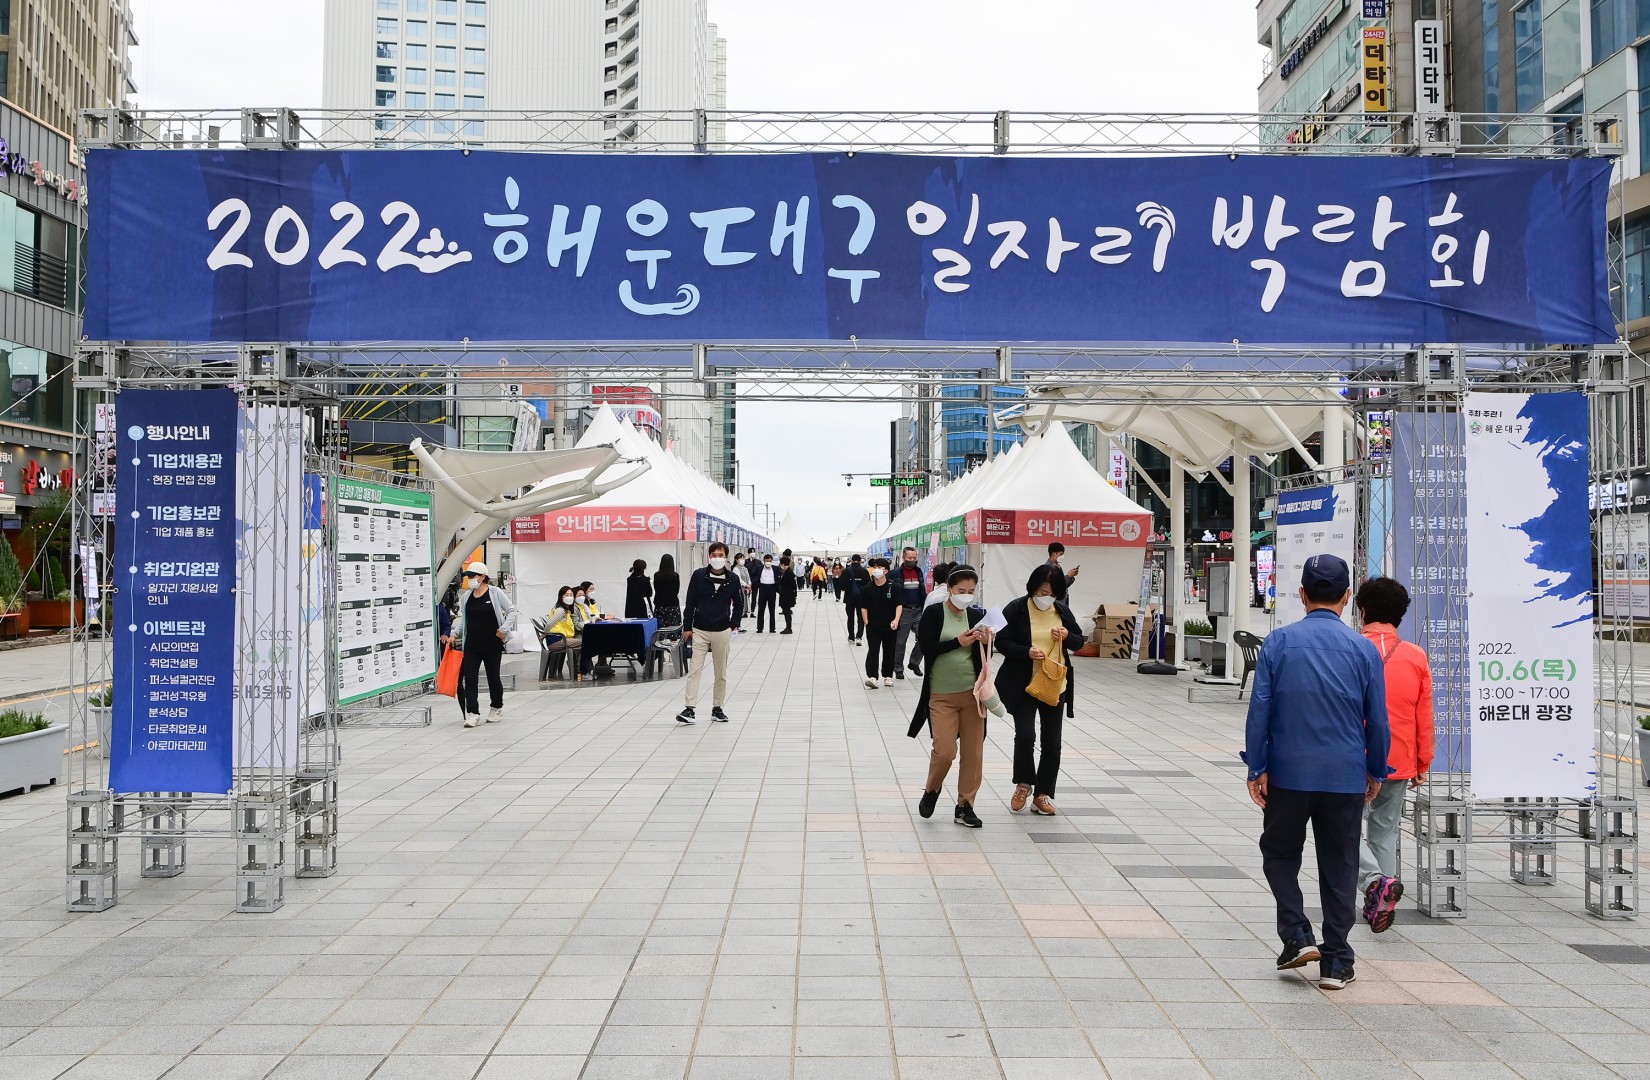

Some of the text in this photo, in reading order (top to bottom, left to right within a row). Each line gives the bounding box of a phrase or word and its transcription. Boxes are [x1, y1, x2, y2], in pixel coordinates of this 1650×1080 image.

[1366, 8, 1383, 17] 의원
[1364, 31, 1384, 39] 24시간
[1421, 26, 1440, 105] 티키타카
[1365, 44, 1387, 107] 더타이
[207, 177, 1489, 315] 2022 해운대구 일자리 박람회
[146, 424, 210, 441] 행사안내
[1485, 424, 1523, 434] 해운대구
[147, 453, 223, 469] 기업채용관
[1113, 454, 1123, 489] 낙곱새
[152, 474, 216, 486] 현장 면접 진행
[146, 505, 222, 521] 기업홍보관
[556, 514, 647, 534] 안내데스크
[986, 523, 1010, 531] 해운대구
[1026, 518, 1118, 538] 안내데스크
[152, 527, 215, 538] 기업 제품 홍보
[143, 561, 220, 577] 취업지원관
[148, 583, 219, 594] 일자리 지원사업
[147, 595, 169, 606] 안내
[143, 620, 207, 637] 이벤트관
[149, 641, 199, 653] AI모의면접
[1478, 642, 1516, 656] 2022.
[149, 658, 198, 669] 취업컨설팅
[1478, 659, 1577, 682] 10.6(목)
[149, 674, 216, 686] 퍼스널컬러진단
[149, 690, 207, 702] 컬러성격유형
[1478, 687, 1514, 700] 13:00
[1530, 686, 1570, 700] 17:00
[148, 707, 189, 718] 분석상담
[1478, 704, 1573, 722] 해운대 광장
[148, 723, 207, 735] 타로취업운세
[147, 740, 207, 751] 아로마테라피
